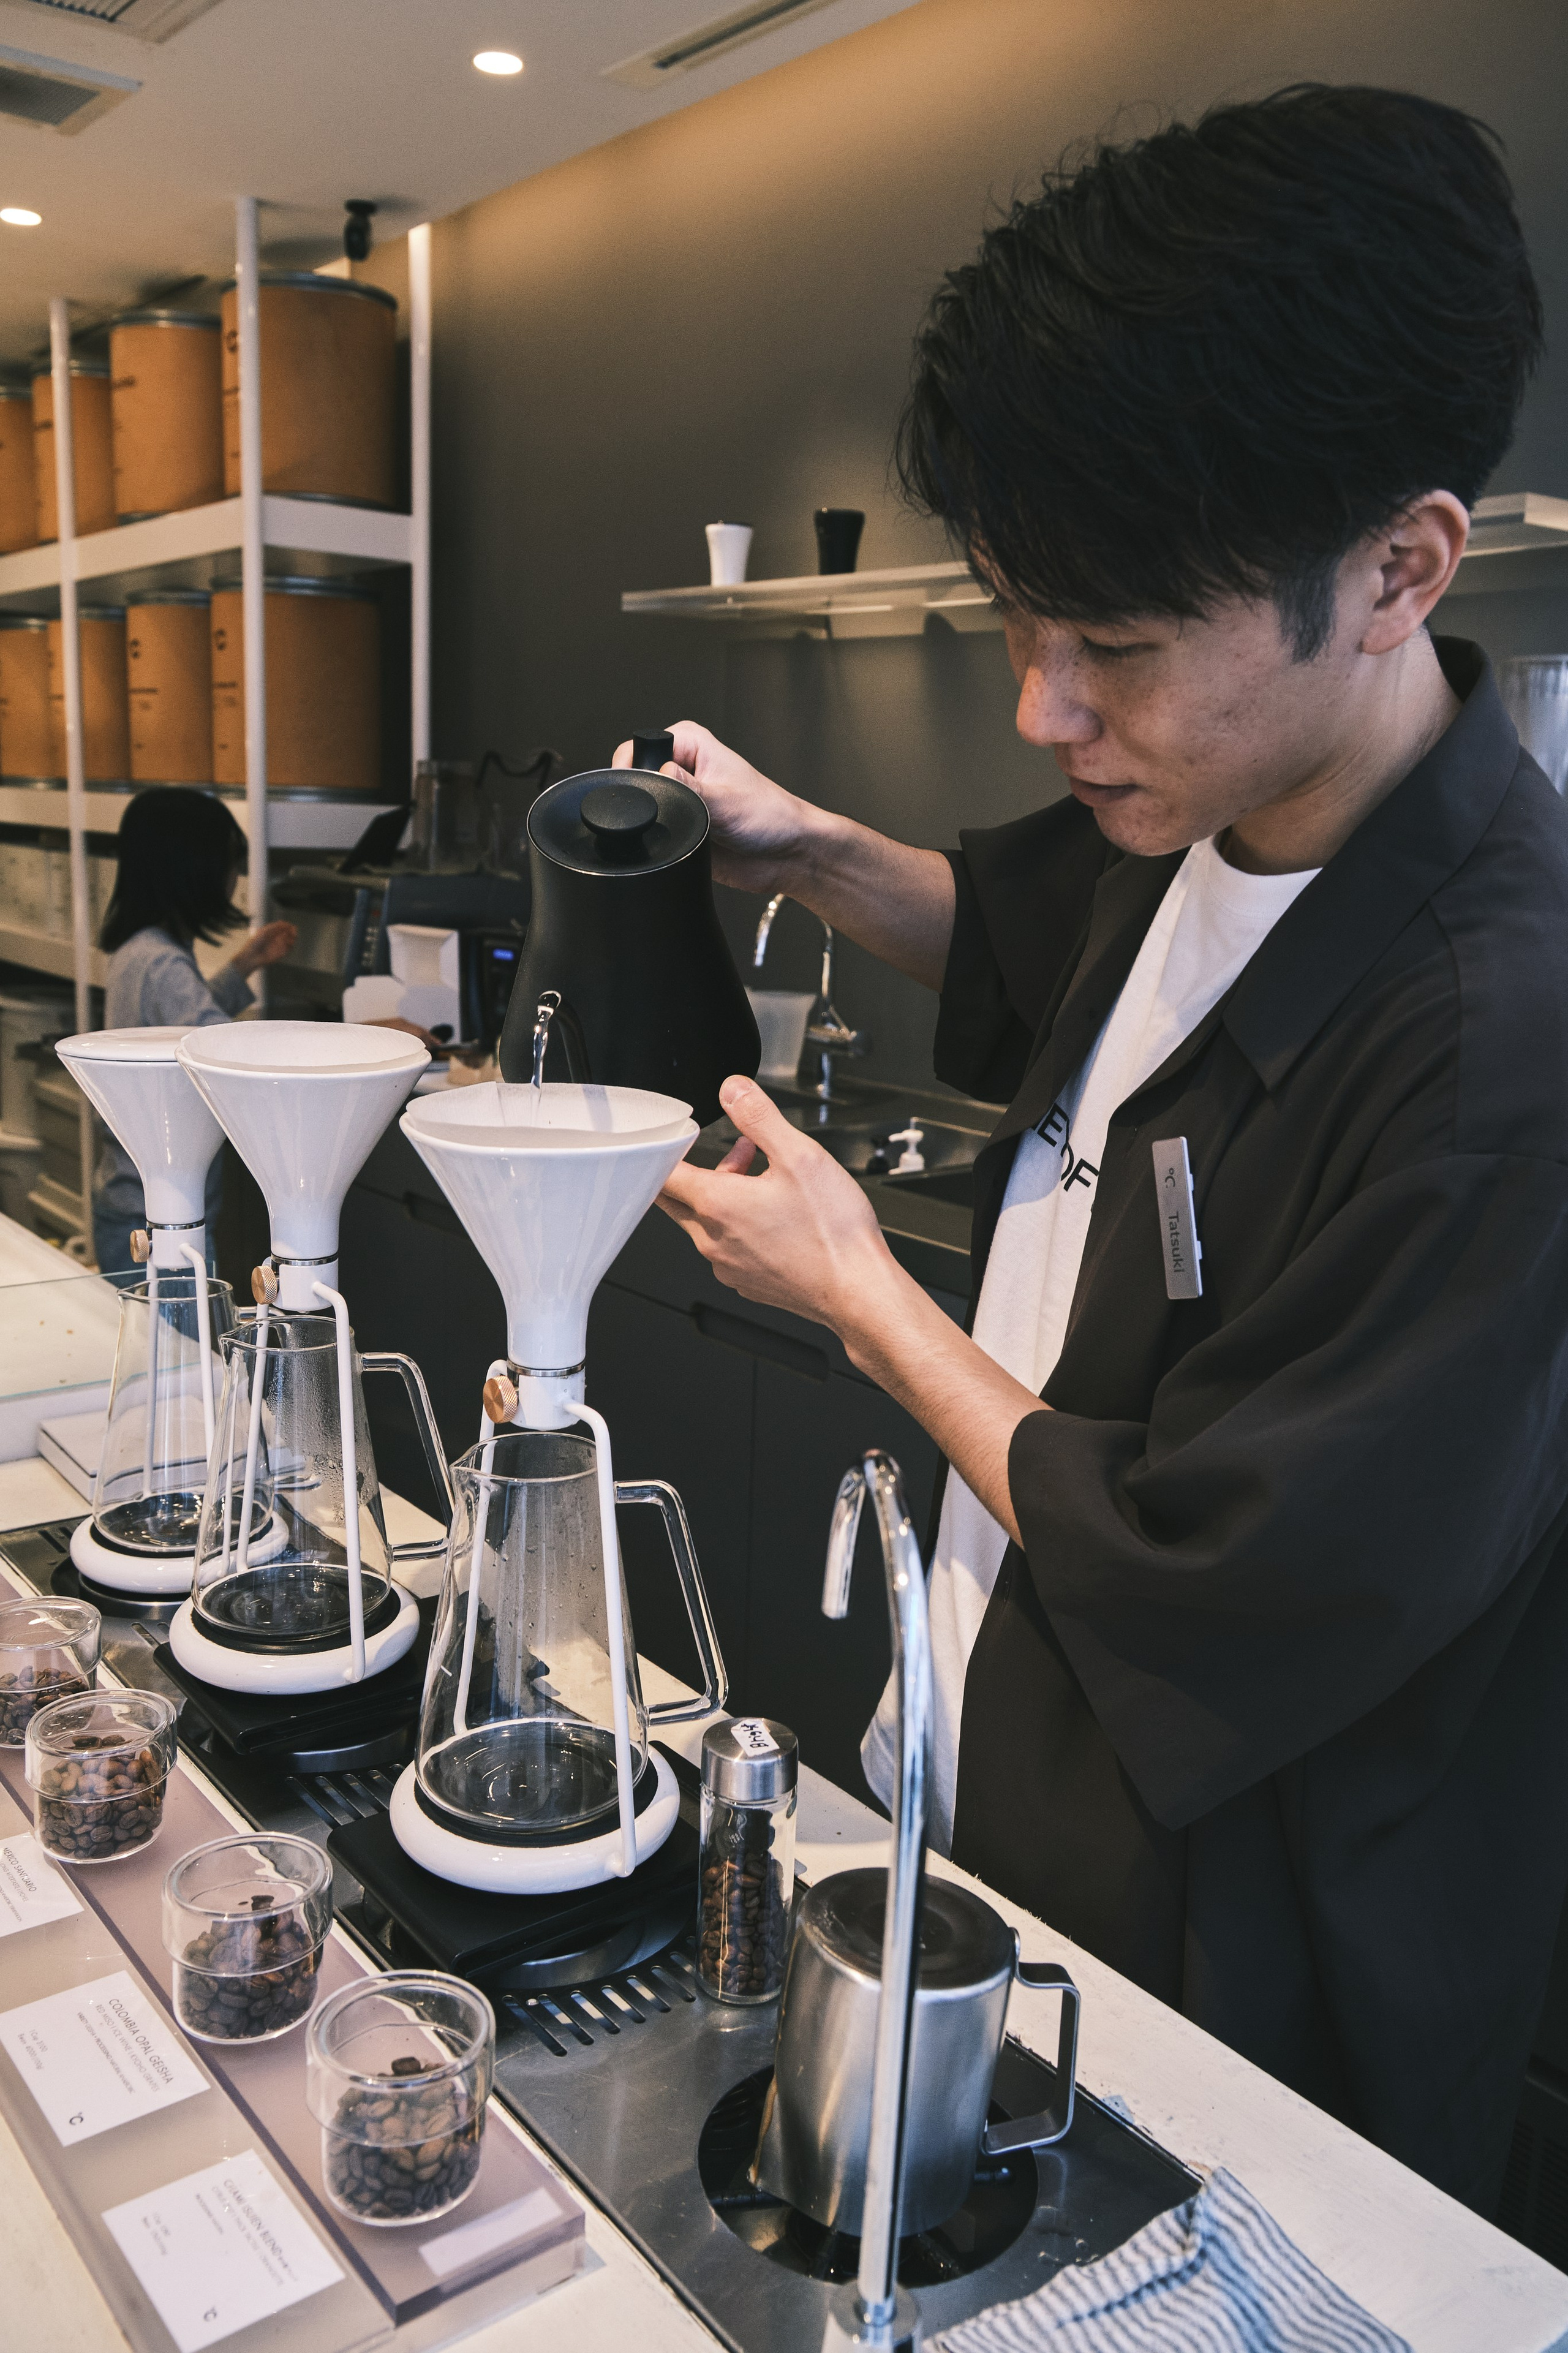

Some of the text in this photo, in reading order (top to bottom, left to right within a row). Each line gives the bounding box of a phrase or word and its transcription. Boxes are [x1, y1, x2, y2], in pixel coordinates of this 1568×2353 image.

[1168, 1211, 1185, 1272] Tatsuki
[4, 1847, 37, 1892] MEXICO SANTUARIO
[95, 2004, 106, 2013] RED
[119, 2037, 132, 2052] WINE
[109, 1999, 173, 2084] COLOMBIA OPAL GEISHA
